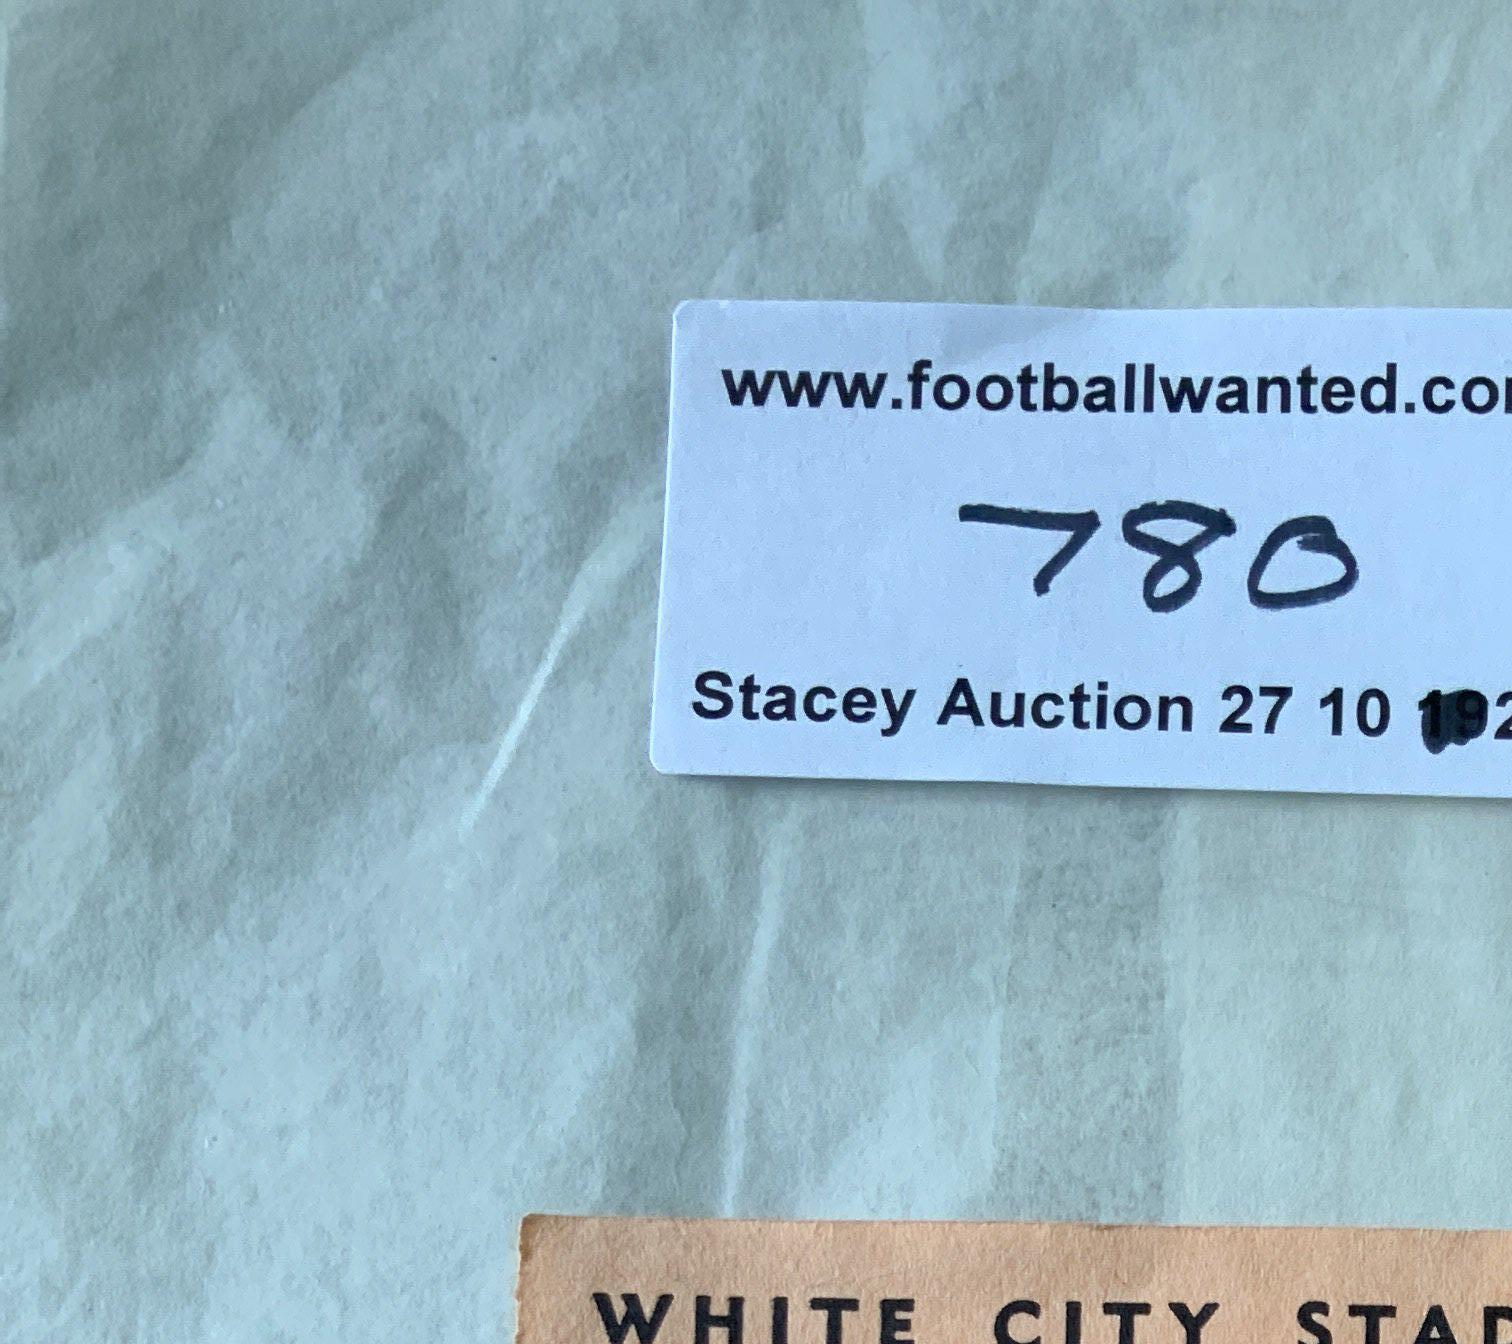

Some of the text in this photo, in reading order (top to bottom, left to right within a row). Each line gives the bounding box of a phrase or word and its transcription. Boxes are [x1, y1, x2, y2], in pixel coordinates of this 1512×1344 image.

[958, 499, 1359, 614] 780
[691, 670, 917, 737] Stacey
[936, 677, 1193, 732] Auction
[1219, 684, 1293, 734] 27
[1319, 687, 1391, 737] 10
